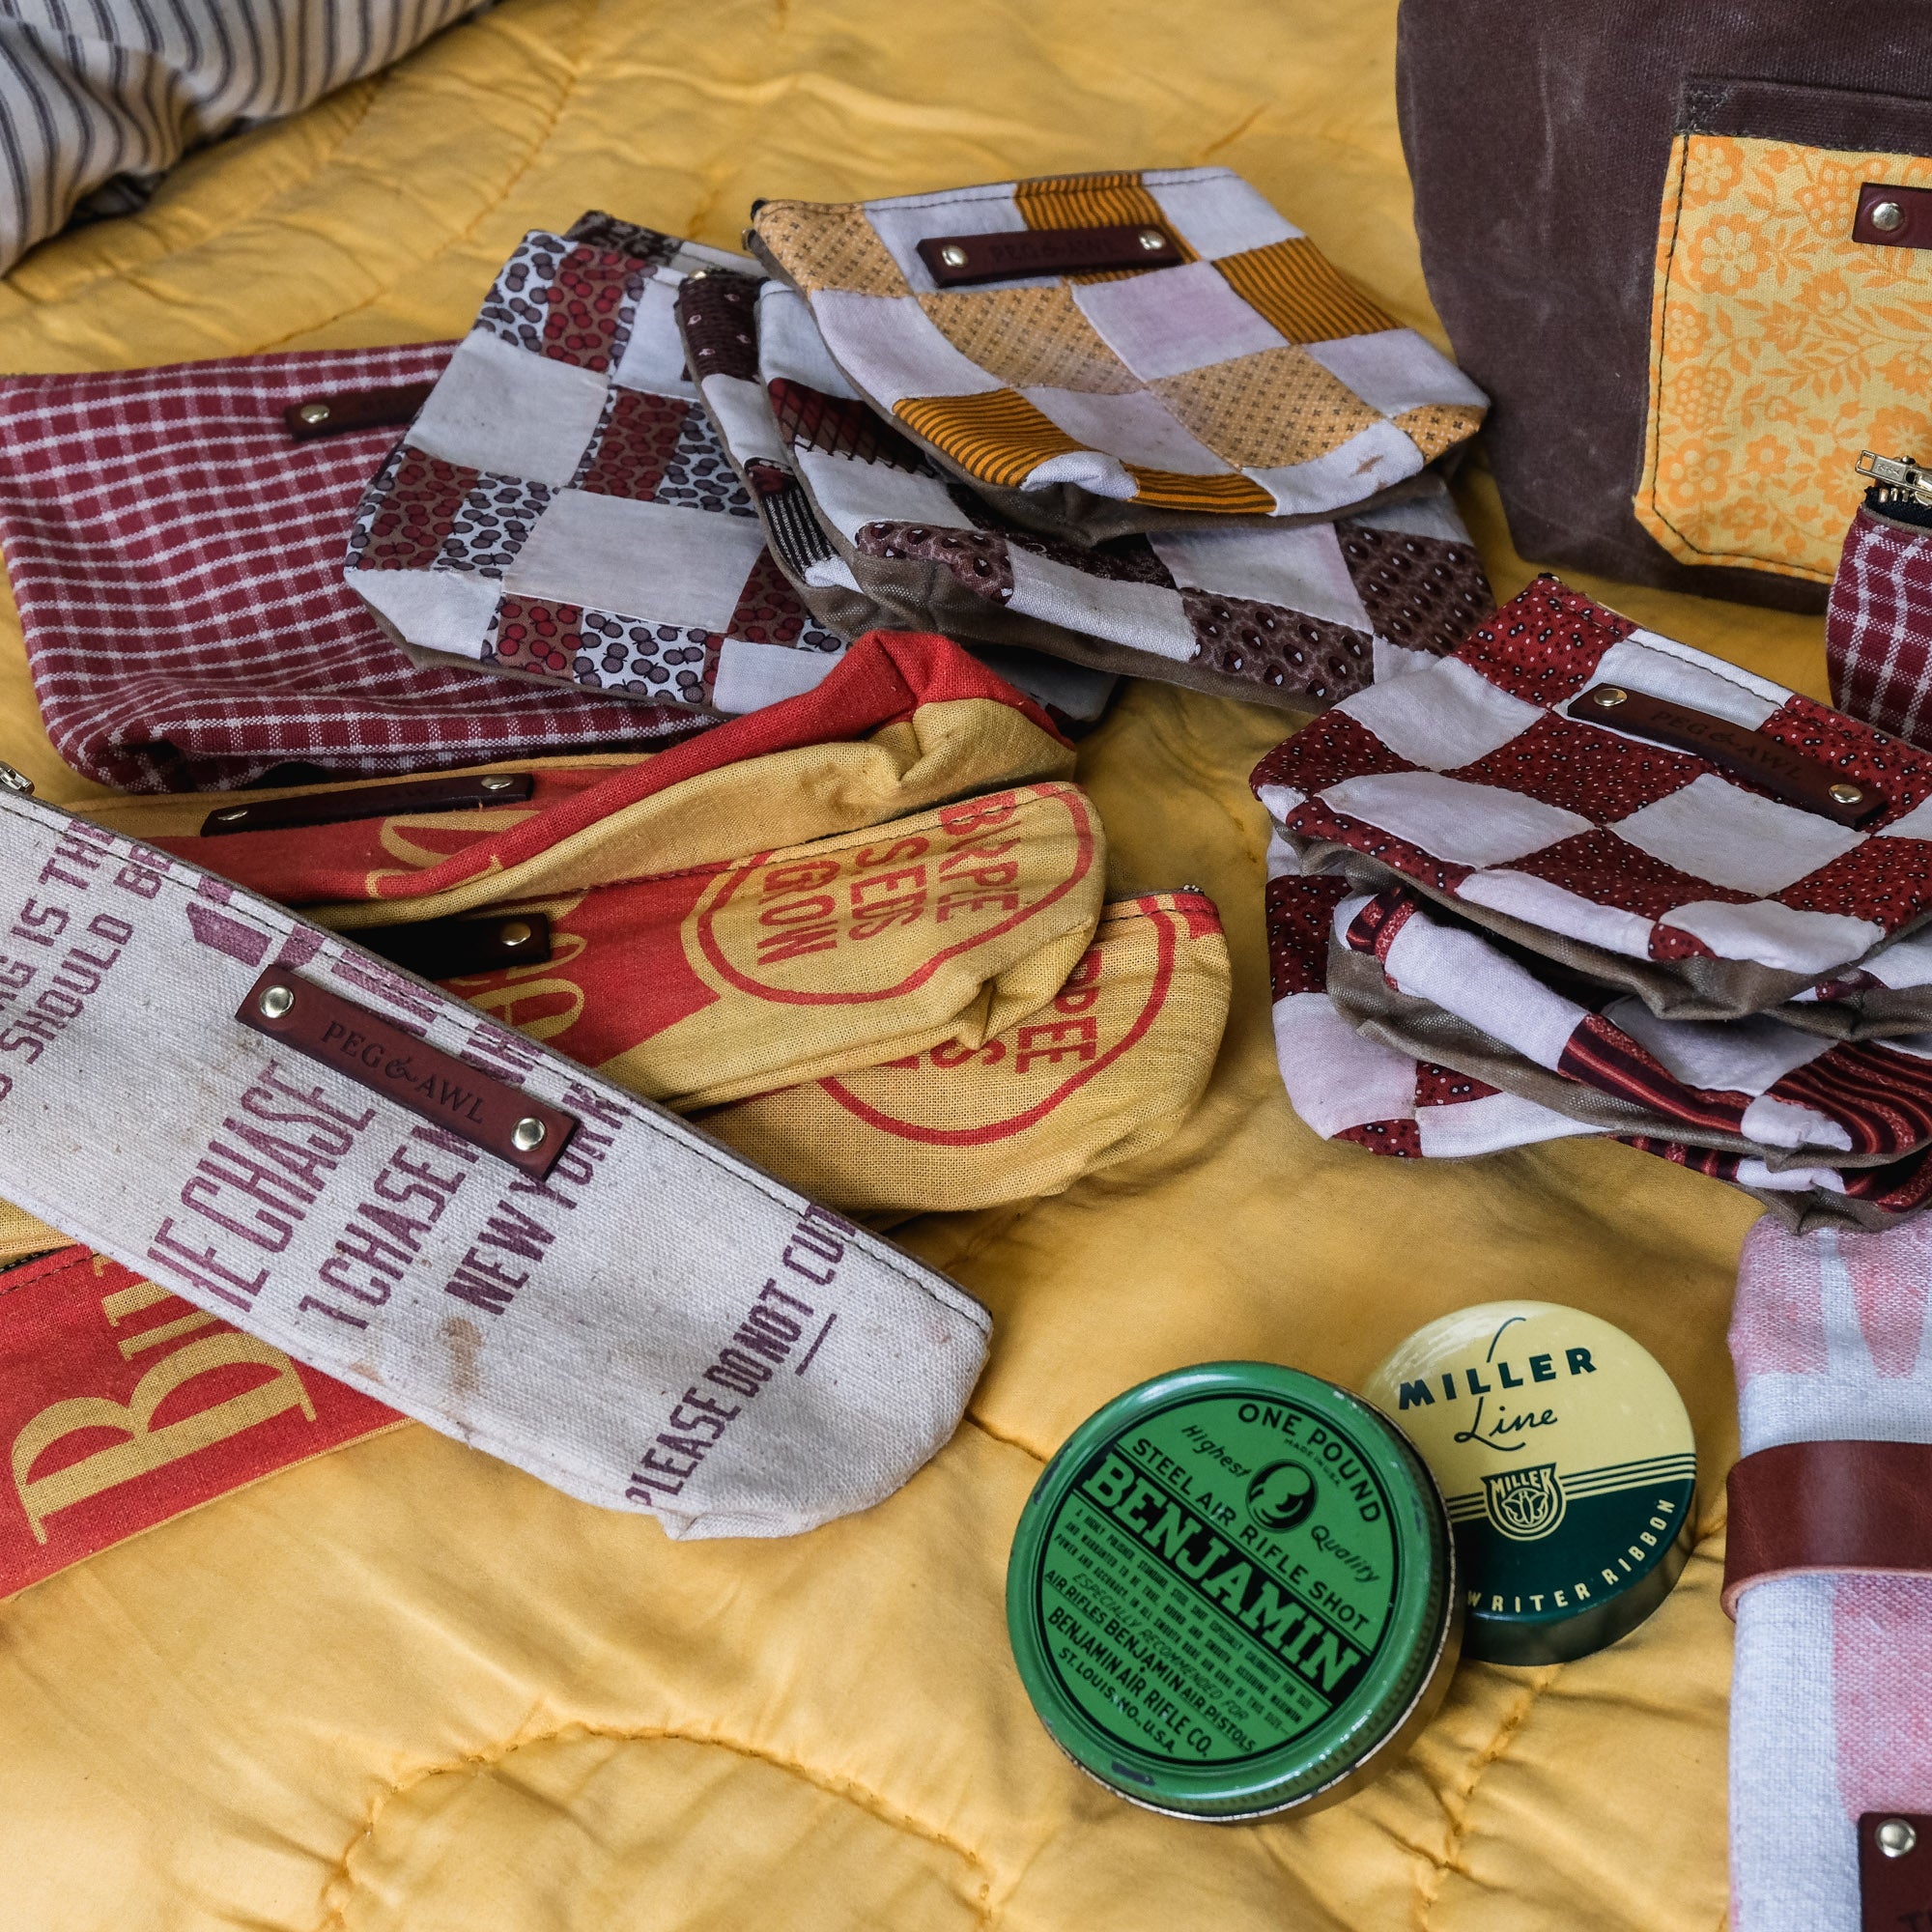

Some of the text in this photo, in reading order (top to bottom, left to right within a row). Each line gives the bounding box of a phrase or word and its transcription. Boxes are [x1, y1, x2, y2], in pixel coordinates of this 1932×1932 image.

[11, 896, 70, 947] IS
[181, 1060, 377, 1253] CHASE
[319, 1145, 467, 1307] CHASE
[443, 1200, 556, 1316] NEW
[702, 1349, 774, 1398] DO
[733, 1278, 814, 1364] NOT
[1399, 1348, 1597, 1410] MILLER
[625, 1386, 742, 1507] PLEASE
[1237, 1403, 1379, 1520] ONE POUND
[1454, 1396, 1557, 1451] Line
[1130, 1436, 1370, 1634] STEEL AIR RIFLE SHOT
[1182, 1424, 1382, 1581] Highest Quality
[1490, 1468, 1552, 1499] MILLER
[1080, 1450, 1362, 1692] BENJAMIN
[1466, 1498, 1676, 1613] WRITER RIBBON
[1044, 1567, 1257, 1752] AIR RIFLES BENJAMIN AIR PISTOLS
[1046, 1605, 1217, 1757] BENJAMIN AIR RIFLE CO.
[1057, 1645, 1080, 1667] ST.
